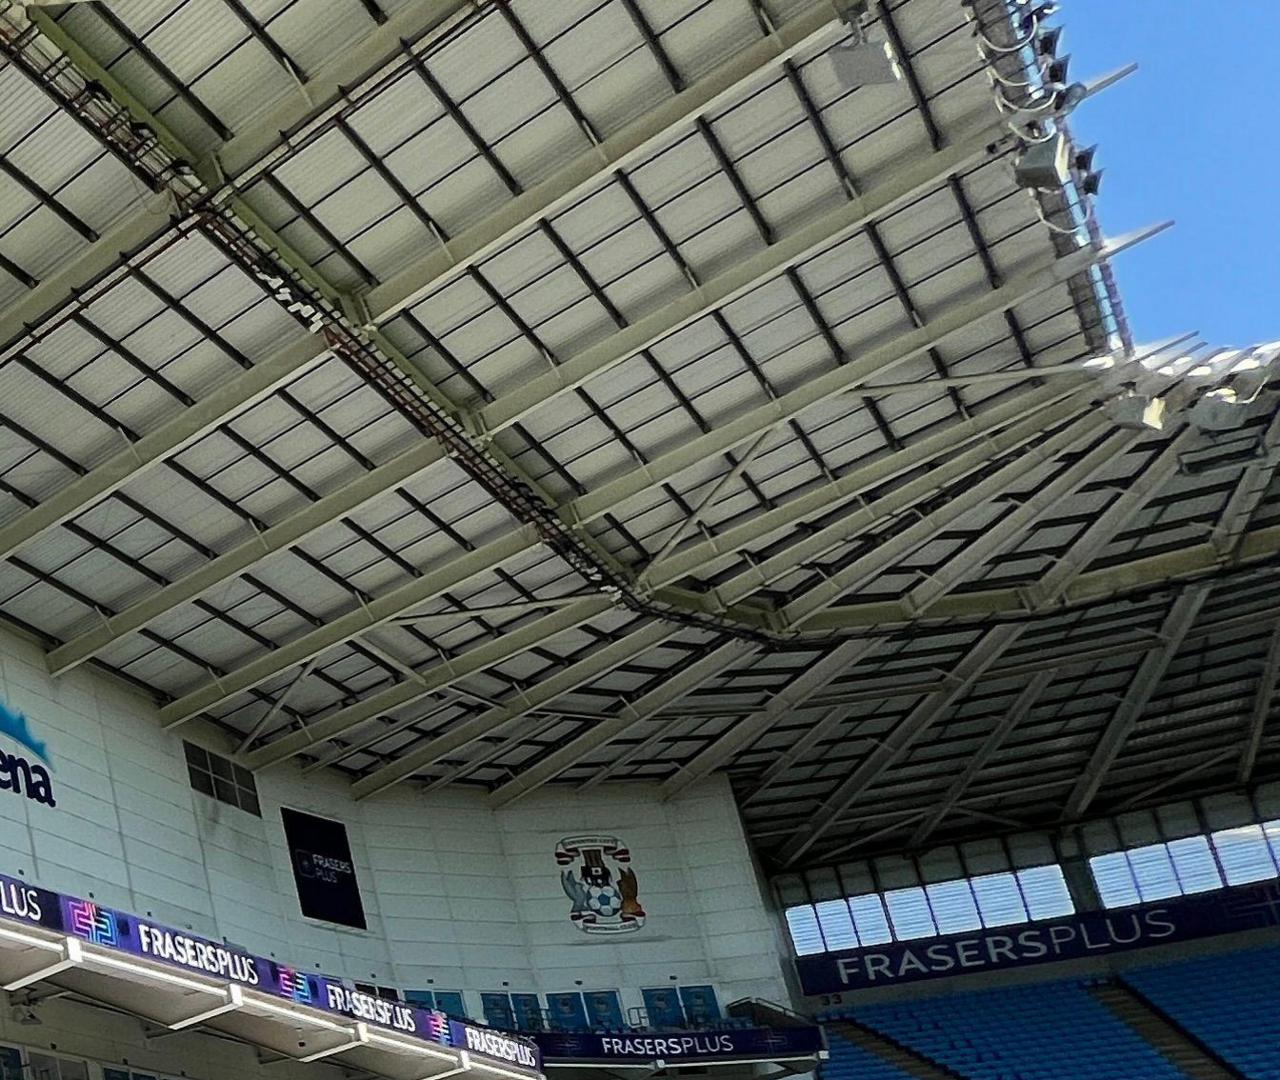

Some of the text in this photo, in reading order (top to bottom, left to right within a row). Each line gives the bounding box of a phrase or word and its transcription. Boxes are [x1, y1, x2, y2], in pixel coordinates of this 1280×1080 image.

[138, 923, 259, 986] FRASERSPLUS
[837, 908, 1176, 985] FRASERSPLUS
[327, 984, 416, 1033] FRASERSPLUS
[466, 1027, 537, 1067] FRASERSPLUS
[602, 1035, 734, 1056] FRASERSPLUS
